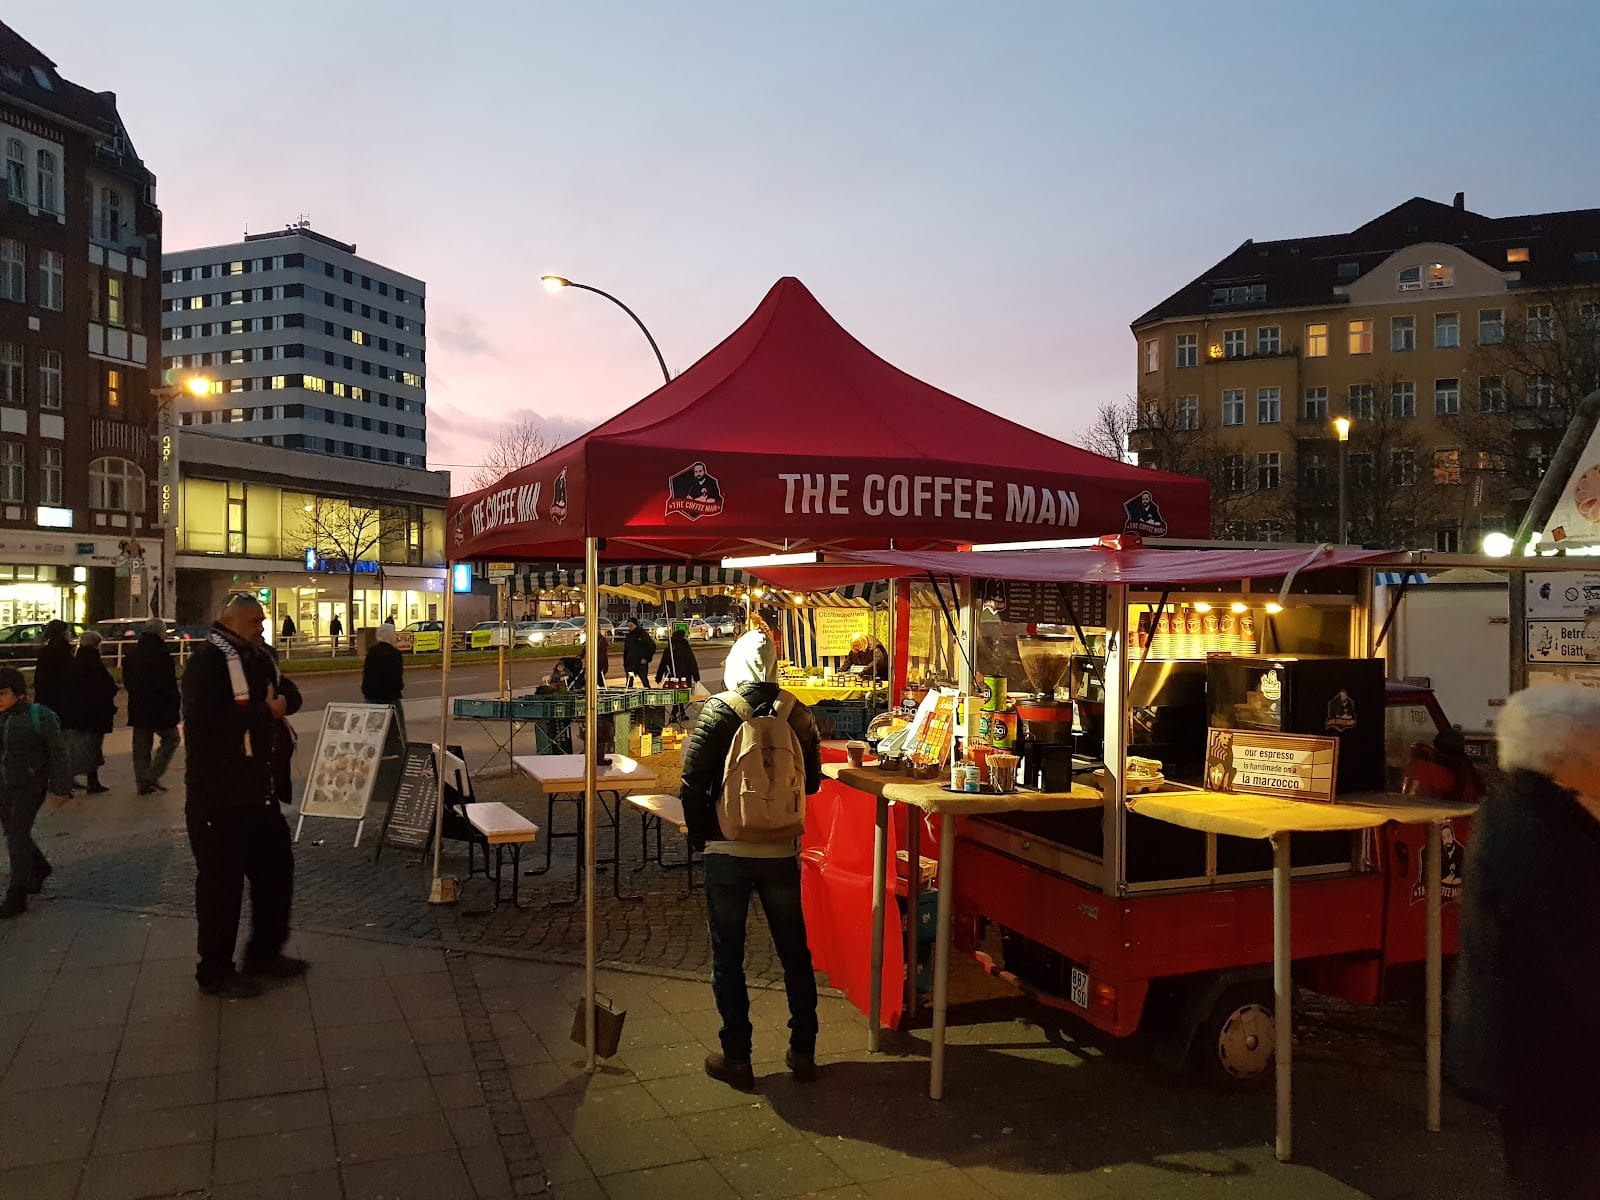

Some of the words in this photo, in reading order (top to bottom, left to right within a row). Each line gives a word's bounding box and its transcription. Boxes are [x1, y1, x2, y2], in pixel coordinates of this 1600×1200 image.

[671, 501, 684, 509] THE
[685, 501, 704, 512] COFFEE
[778, 473, 849, 514] THE
[862, 473, 994, 521] COFFEE
[1005, 483, 1080, 528] MAN
[471, 500, 485, 537] THE
[486, 487, 518, 531] COFFEE
[517, 481, 541, 523] MAN
[1561, 644, 1586, 657] Glätt
[1244, 748, 1257, 757] our
[1259, 749, 1294, 761] espresso
[1243, 761, 1249, 769] is
[1249, 761, 1285, 772] handmade
[1242, 773, 1250, 784] la
[1252, 776, 1299, 789] marzocco
